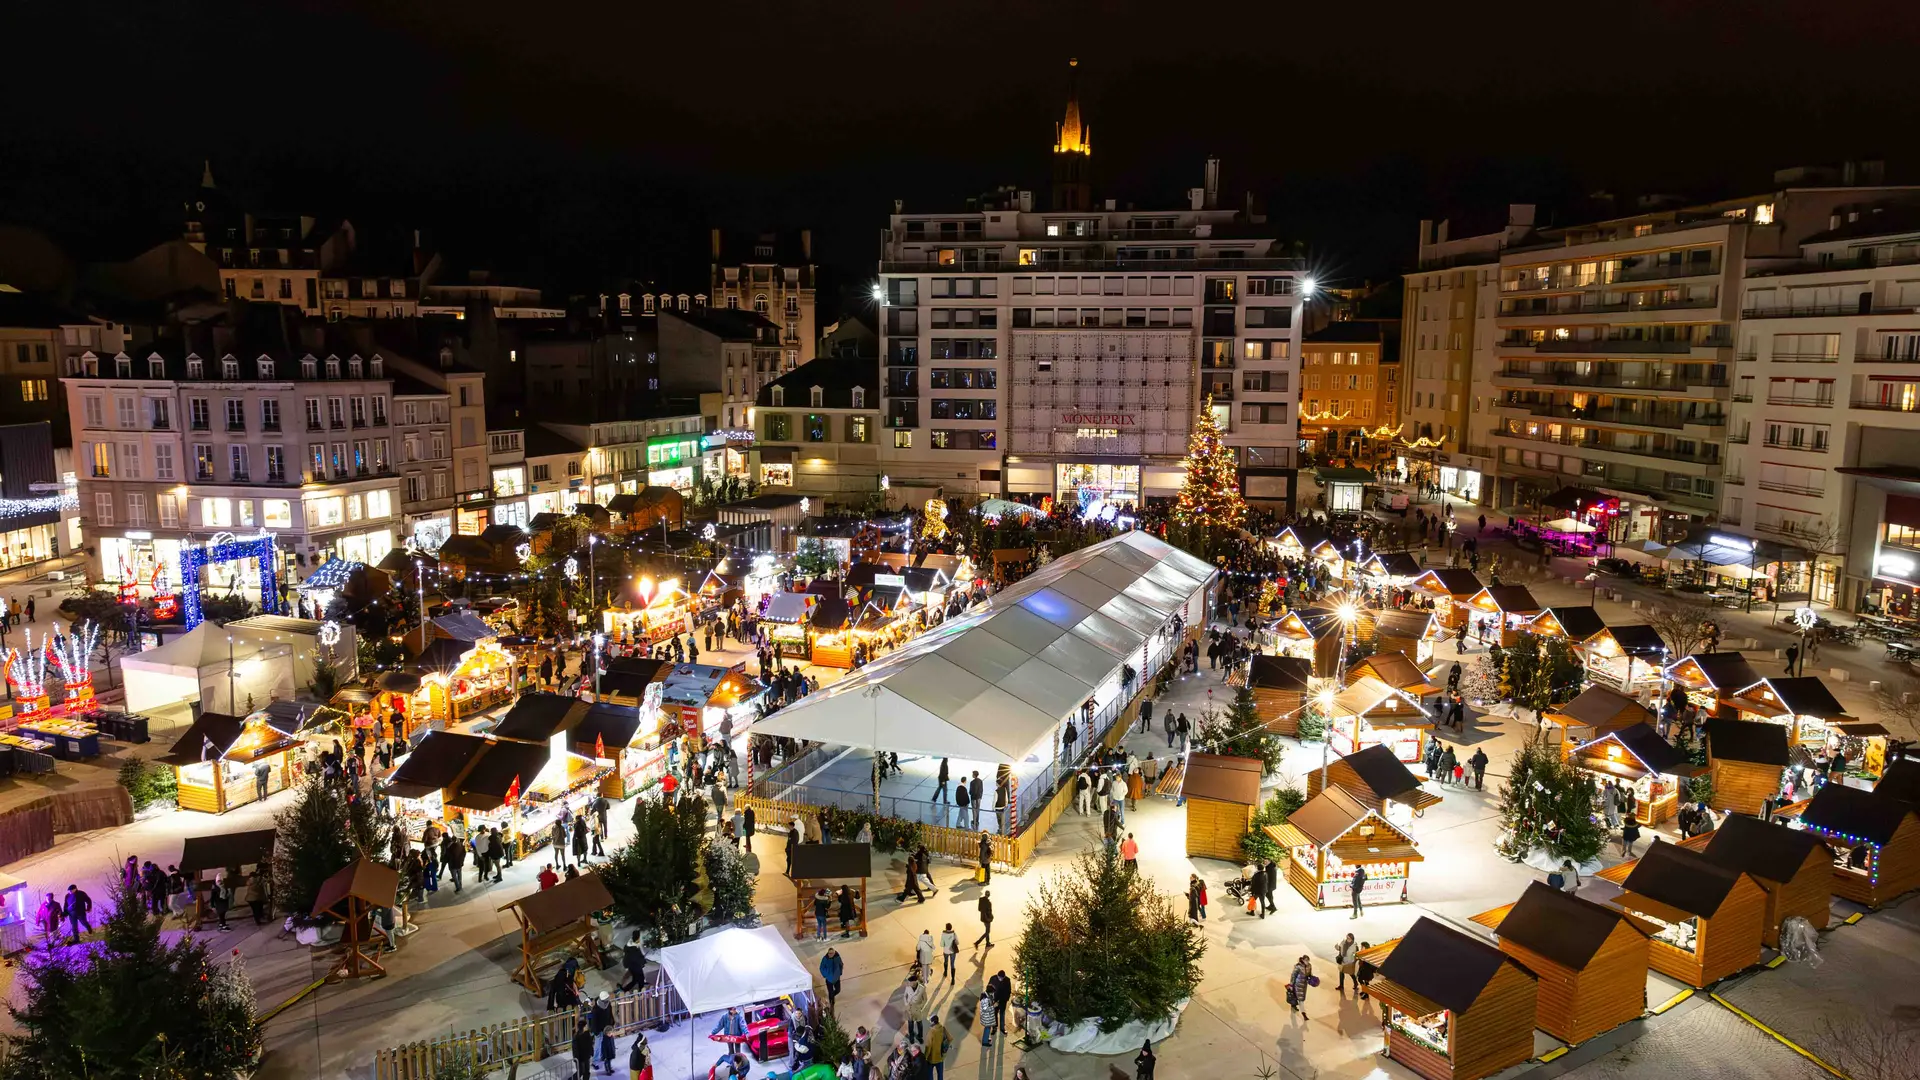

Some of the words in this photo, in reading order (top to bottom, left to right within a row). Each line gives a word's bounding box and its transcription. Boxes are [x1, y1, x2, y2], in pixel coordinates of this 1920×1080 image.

[1062, 414, 1135, 426] MONOPRIX
[1332, 885, 1342, 893] Le
[1373, 882, 1384, 890] du
[1385, 881, 1396, 889] 87
